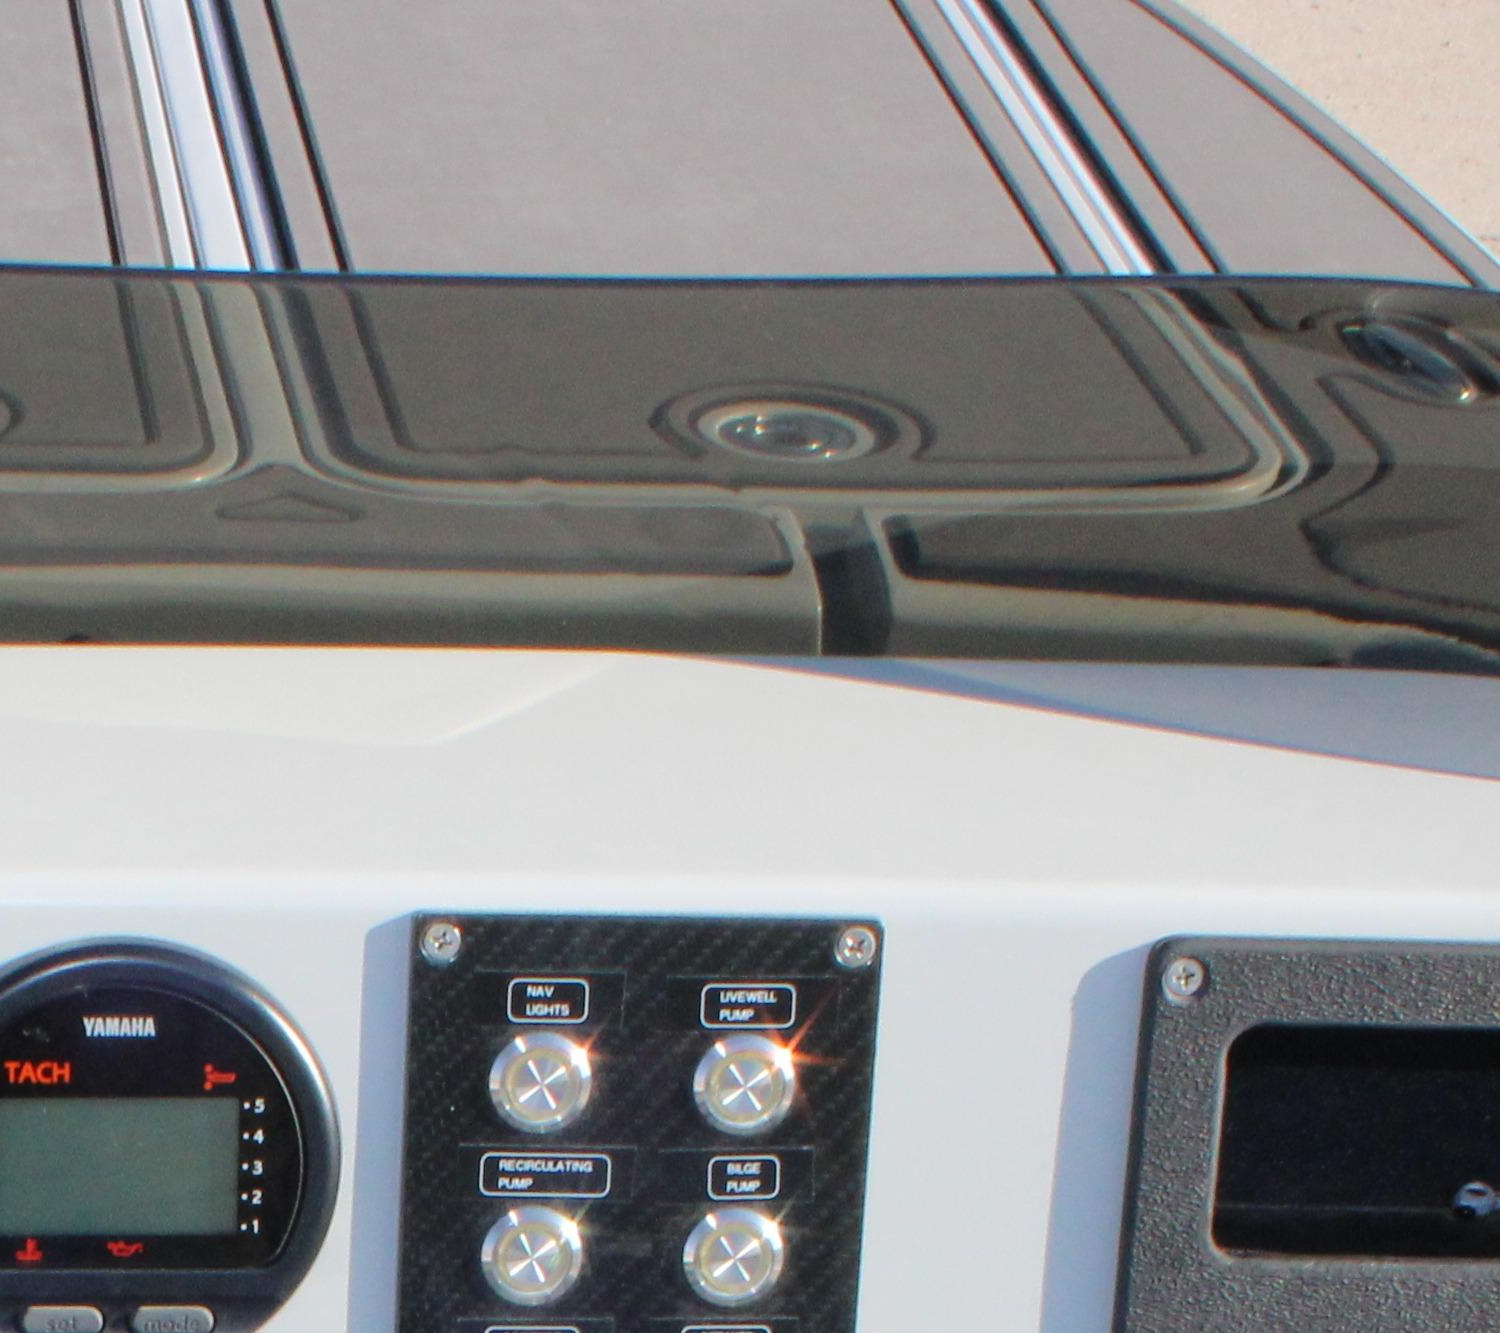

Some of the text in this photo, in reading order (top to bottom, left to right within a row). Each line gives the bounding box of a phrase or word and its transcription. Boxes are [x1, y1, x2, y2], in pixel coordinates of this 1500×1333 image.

[526, 986, 554, 997] NAV
[720, 991, 777, 1003] LIVEWELL
[526, 1003, 569, 1016] LIGHTS
[720, 1009, 753, 1021] PUMP
[83, 1018, 156, 1037] YAMAHA
[4, 1061, 71, 1084] TACH
[255, 1098, 265, 1113] 5
[253, 1129, 264, 1144] 4
[252, 1160, 263, 1175] 3
[726, 1162, 761, 1175] BILGE
[498, 1177, 533, 1189] PUMP
[726, 1180, 761, 1193] PUMP
[252, 1190, 262, 1204] 2
